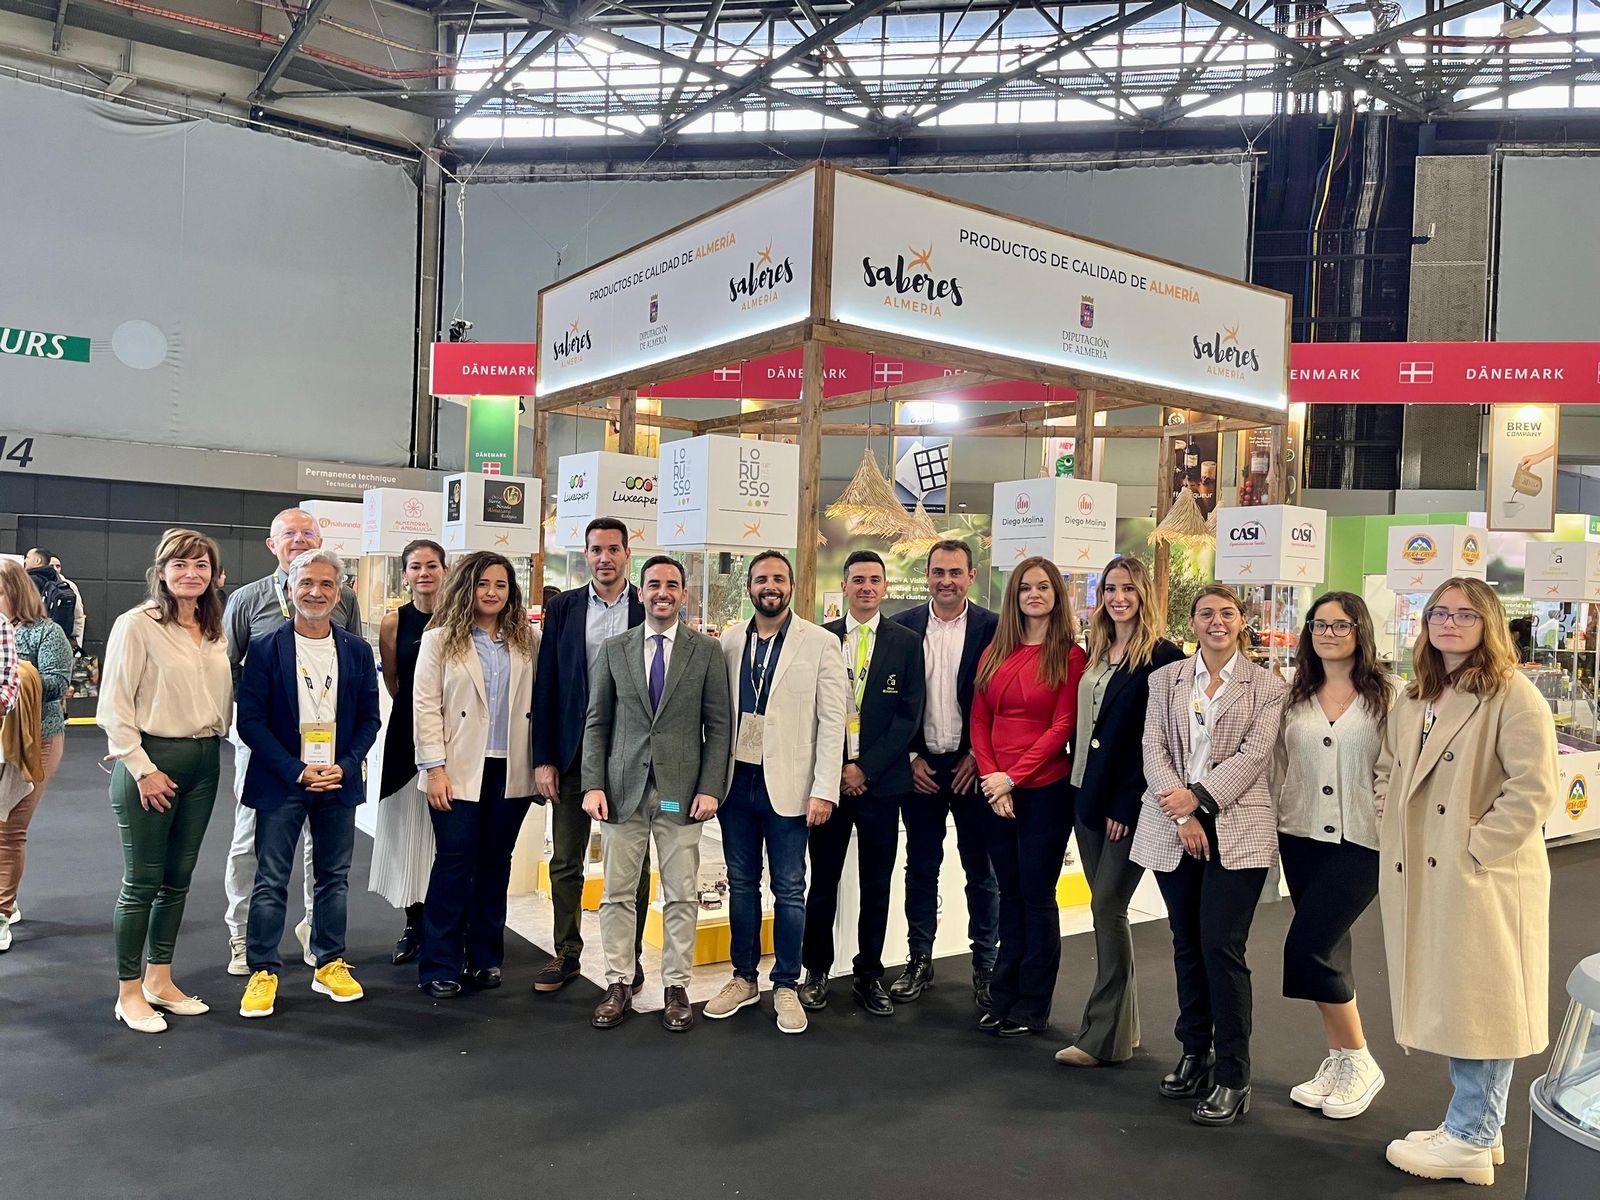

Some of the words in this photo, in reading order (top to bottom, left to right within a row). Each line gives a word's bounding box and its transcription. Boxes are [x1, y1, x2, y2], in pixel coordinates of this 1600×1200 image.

[589, 276, 632, 303] PRODUCTOS
[633, 271, 644, 286] DE
[645, 257, 680, 280] CALIDAD
[681, 250, 694, 265] DE
[695, 232, 736, 259] ALMERÍA
[960, 229, 1047, 265] PRODUCTOS
[1051, 253, 1069, 270] DE
[1072, 260, 1127, 284] CALIDAD
[1131, 274, 1147, 290] DE
[1149, 280, 1200, 304] ALMERÍA
[884, 295, 942, 317] ALMERÍA
[0, 328, 67, 360] URS
[1062, 330, 1110, 348] DIPUTACIÓN
[1063, 342, 1074, 353] DE
[1075, 344, 1108, 360] ALMERÍA
[462, 363, 535, 376] DÄNEMARK
[767, 366, 847, 379] DÄNEARK
[1206, 365, 1245, 381] ALMERÍA
[1466, 365, 1565, 380] DÄNEMARK
[1507, 422, 1542, 431] BREW
[305, 467, 357, 480] Permanence
[358, 473, 397, 483] technique
[325, 480, 357, 489] Technical
[1002, 518, 1021, 526] Diego
[1022, 516, 1044, 525] Molina
[1064, 516, 1084, 526] Diego
[1085, 518, 1107, 527] Molina
[1230, 527, 1259, 541] CASI
[1291, 528, 1312, 542] CASI
